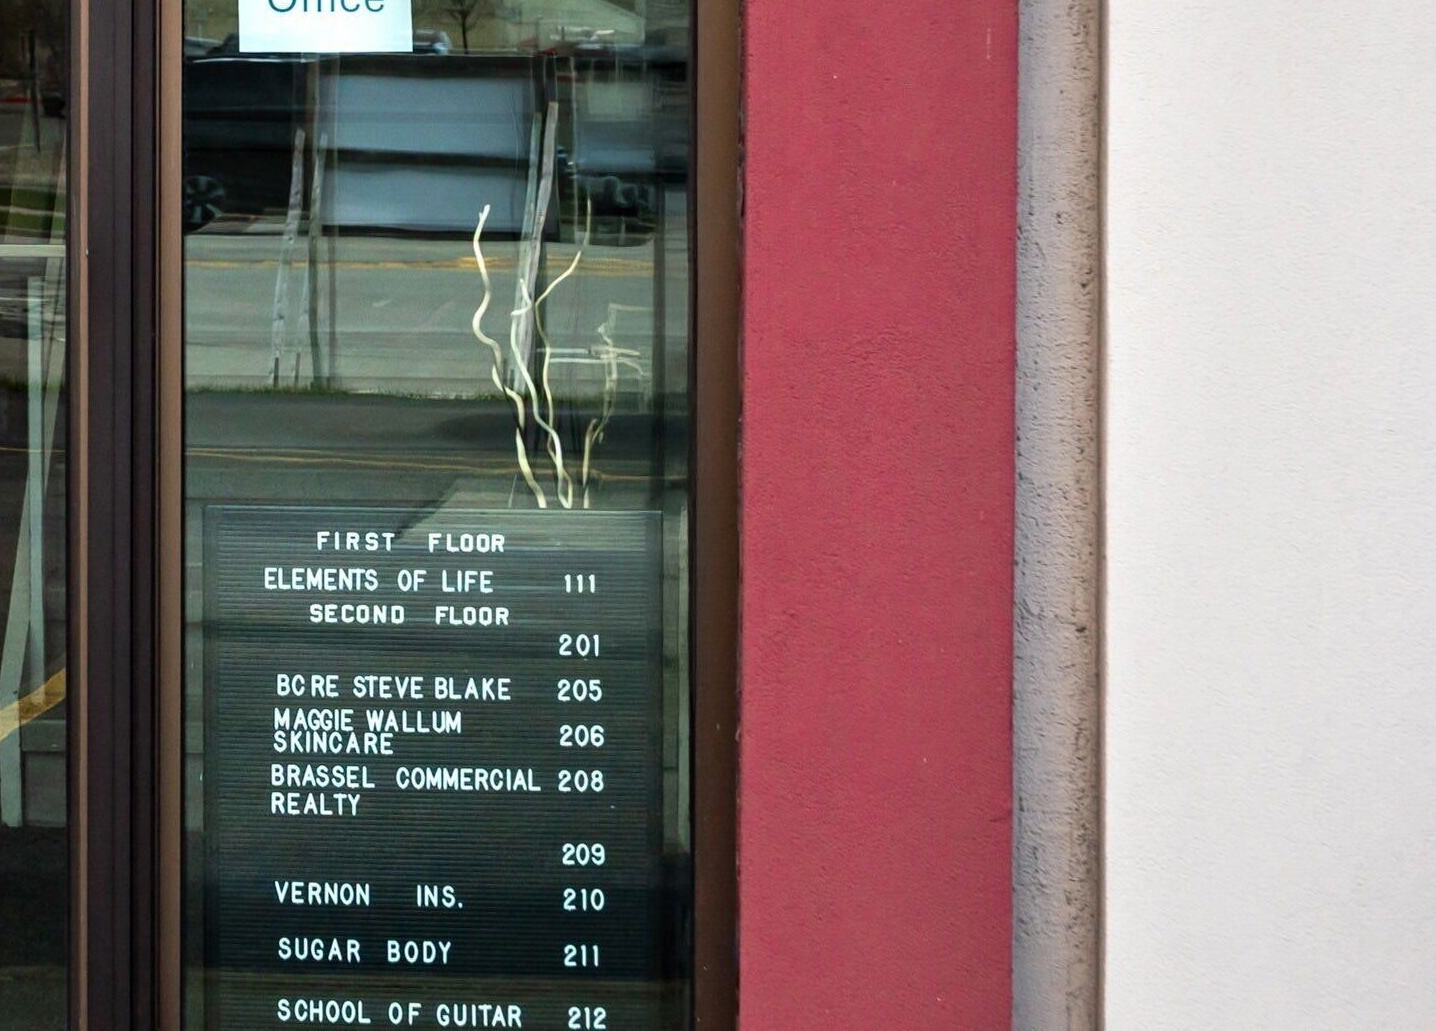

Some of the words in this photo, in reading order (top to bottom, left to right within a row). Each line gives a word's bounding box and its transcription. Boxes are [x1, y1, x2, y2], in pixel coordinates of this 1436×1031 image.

[316, 531, 395, 552] FIRST
[428, 532, 505, 553] FLOOR
[264, 567, 379, 592] ELEMENTS
[397, 569, 427, 592] OF
[441, 569, 494, 594] LIFE
[564, 574, 596, 594] 111
[309, 603, 405, 625] SECOND
[434, 605, 510, 627] FLOOR
[558, 633, 600, 657] 201
[352, 674, 424, 700] STEVE
[434, 676, 512, 701] BLAKE
[557, 678, 603, 702] 205
[273, 707, 354, 732] MAGGIE
[365, 709, 462, 734] WALLUM
[273, 729, 394, 756] SKINCARE
[559, 724, 605, 748] 206
[270, 763, 376, 789] BRASSEL
[395, 766, 542, 792] COMMERCIAL
[557, 769, 605, 793] 208
[270, 791, 361, 817] REALTY
[561, 842, 606, 867] 209
[274, 880, 371, 907] VERNON
[416, 884, 464, 909] INS.
[562, 887, 605, 912] 210
[277, 936, 361, 963] SUGAR
[386, 939, 452, 965] BODY
[563, 944, 599, 968] 211
[276, 998, 372, 1025] SCHOOL
[388, 1001, 422, 1026] OF
[436, 1003, 523, 1029] GUITAR
[567, 1006, 608, 1031] 212
